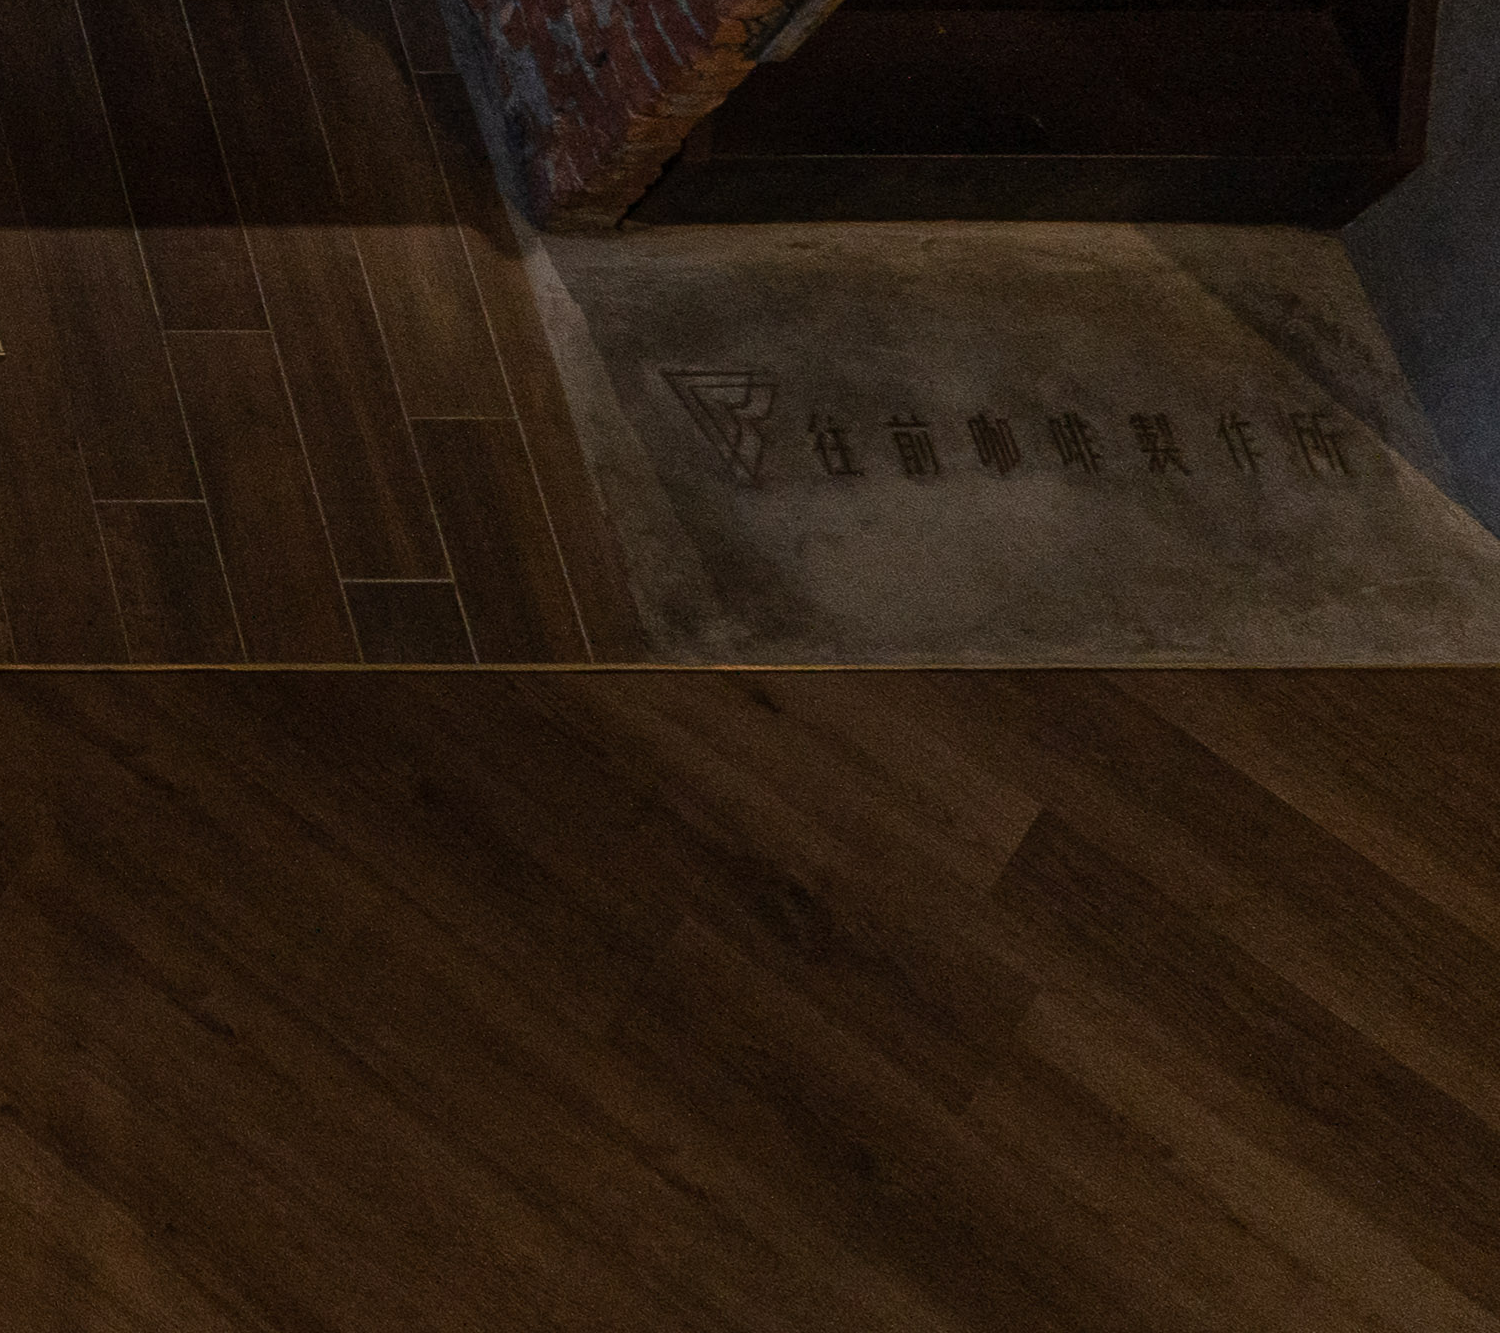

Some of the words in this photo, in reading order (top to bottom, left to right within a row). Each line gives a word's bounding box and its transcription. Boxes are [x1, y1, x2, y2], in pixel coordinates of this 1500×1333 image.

[805, 407, 1357, 480] 往前咖啡製作所
